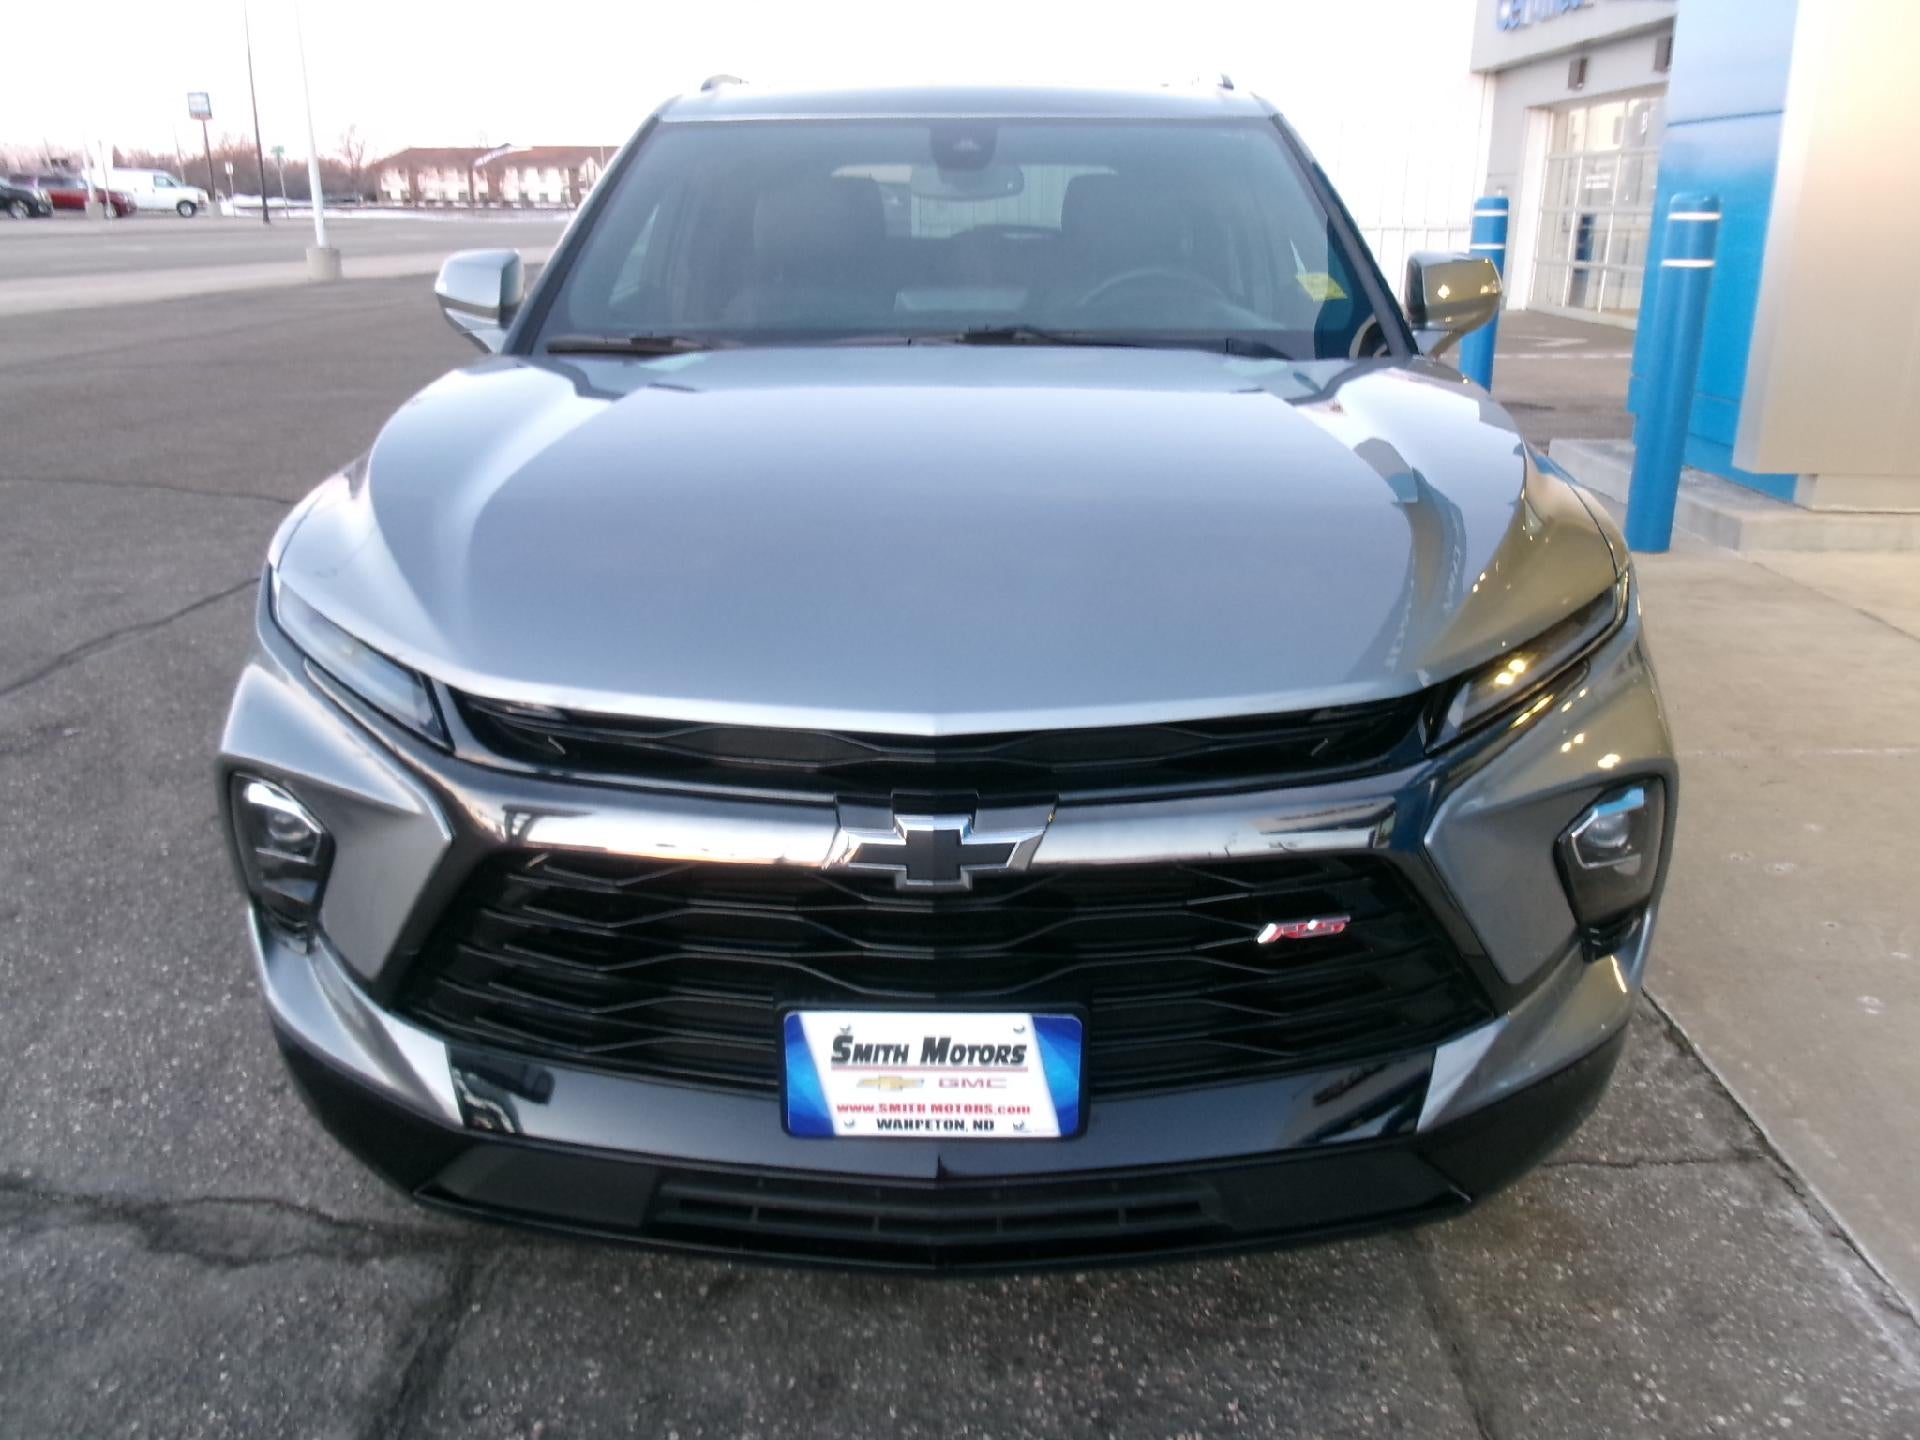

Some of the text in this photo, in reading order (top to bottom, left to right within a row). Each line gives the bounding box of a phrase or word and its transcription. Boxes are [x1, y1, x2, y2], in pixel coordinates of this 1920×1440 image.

[831, 1035, 1027, 1065] SMITH MOTORS
[938, 1077, 1007, 1089] GMC
[973, 1118, 995, 1132] ND
